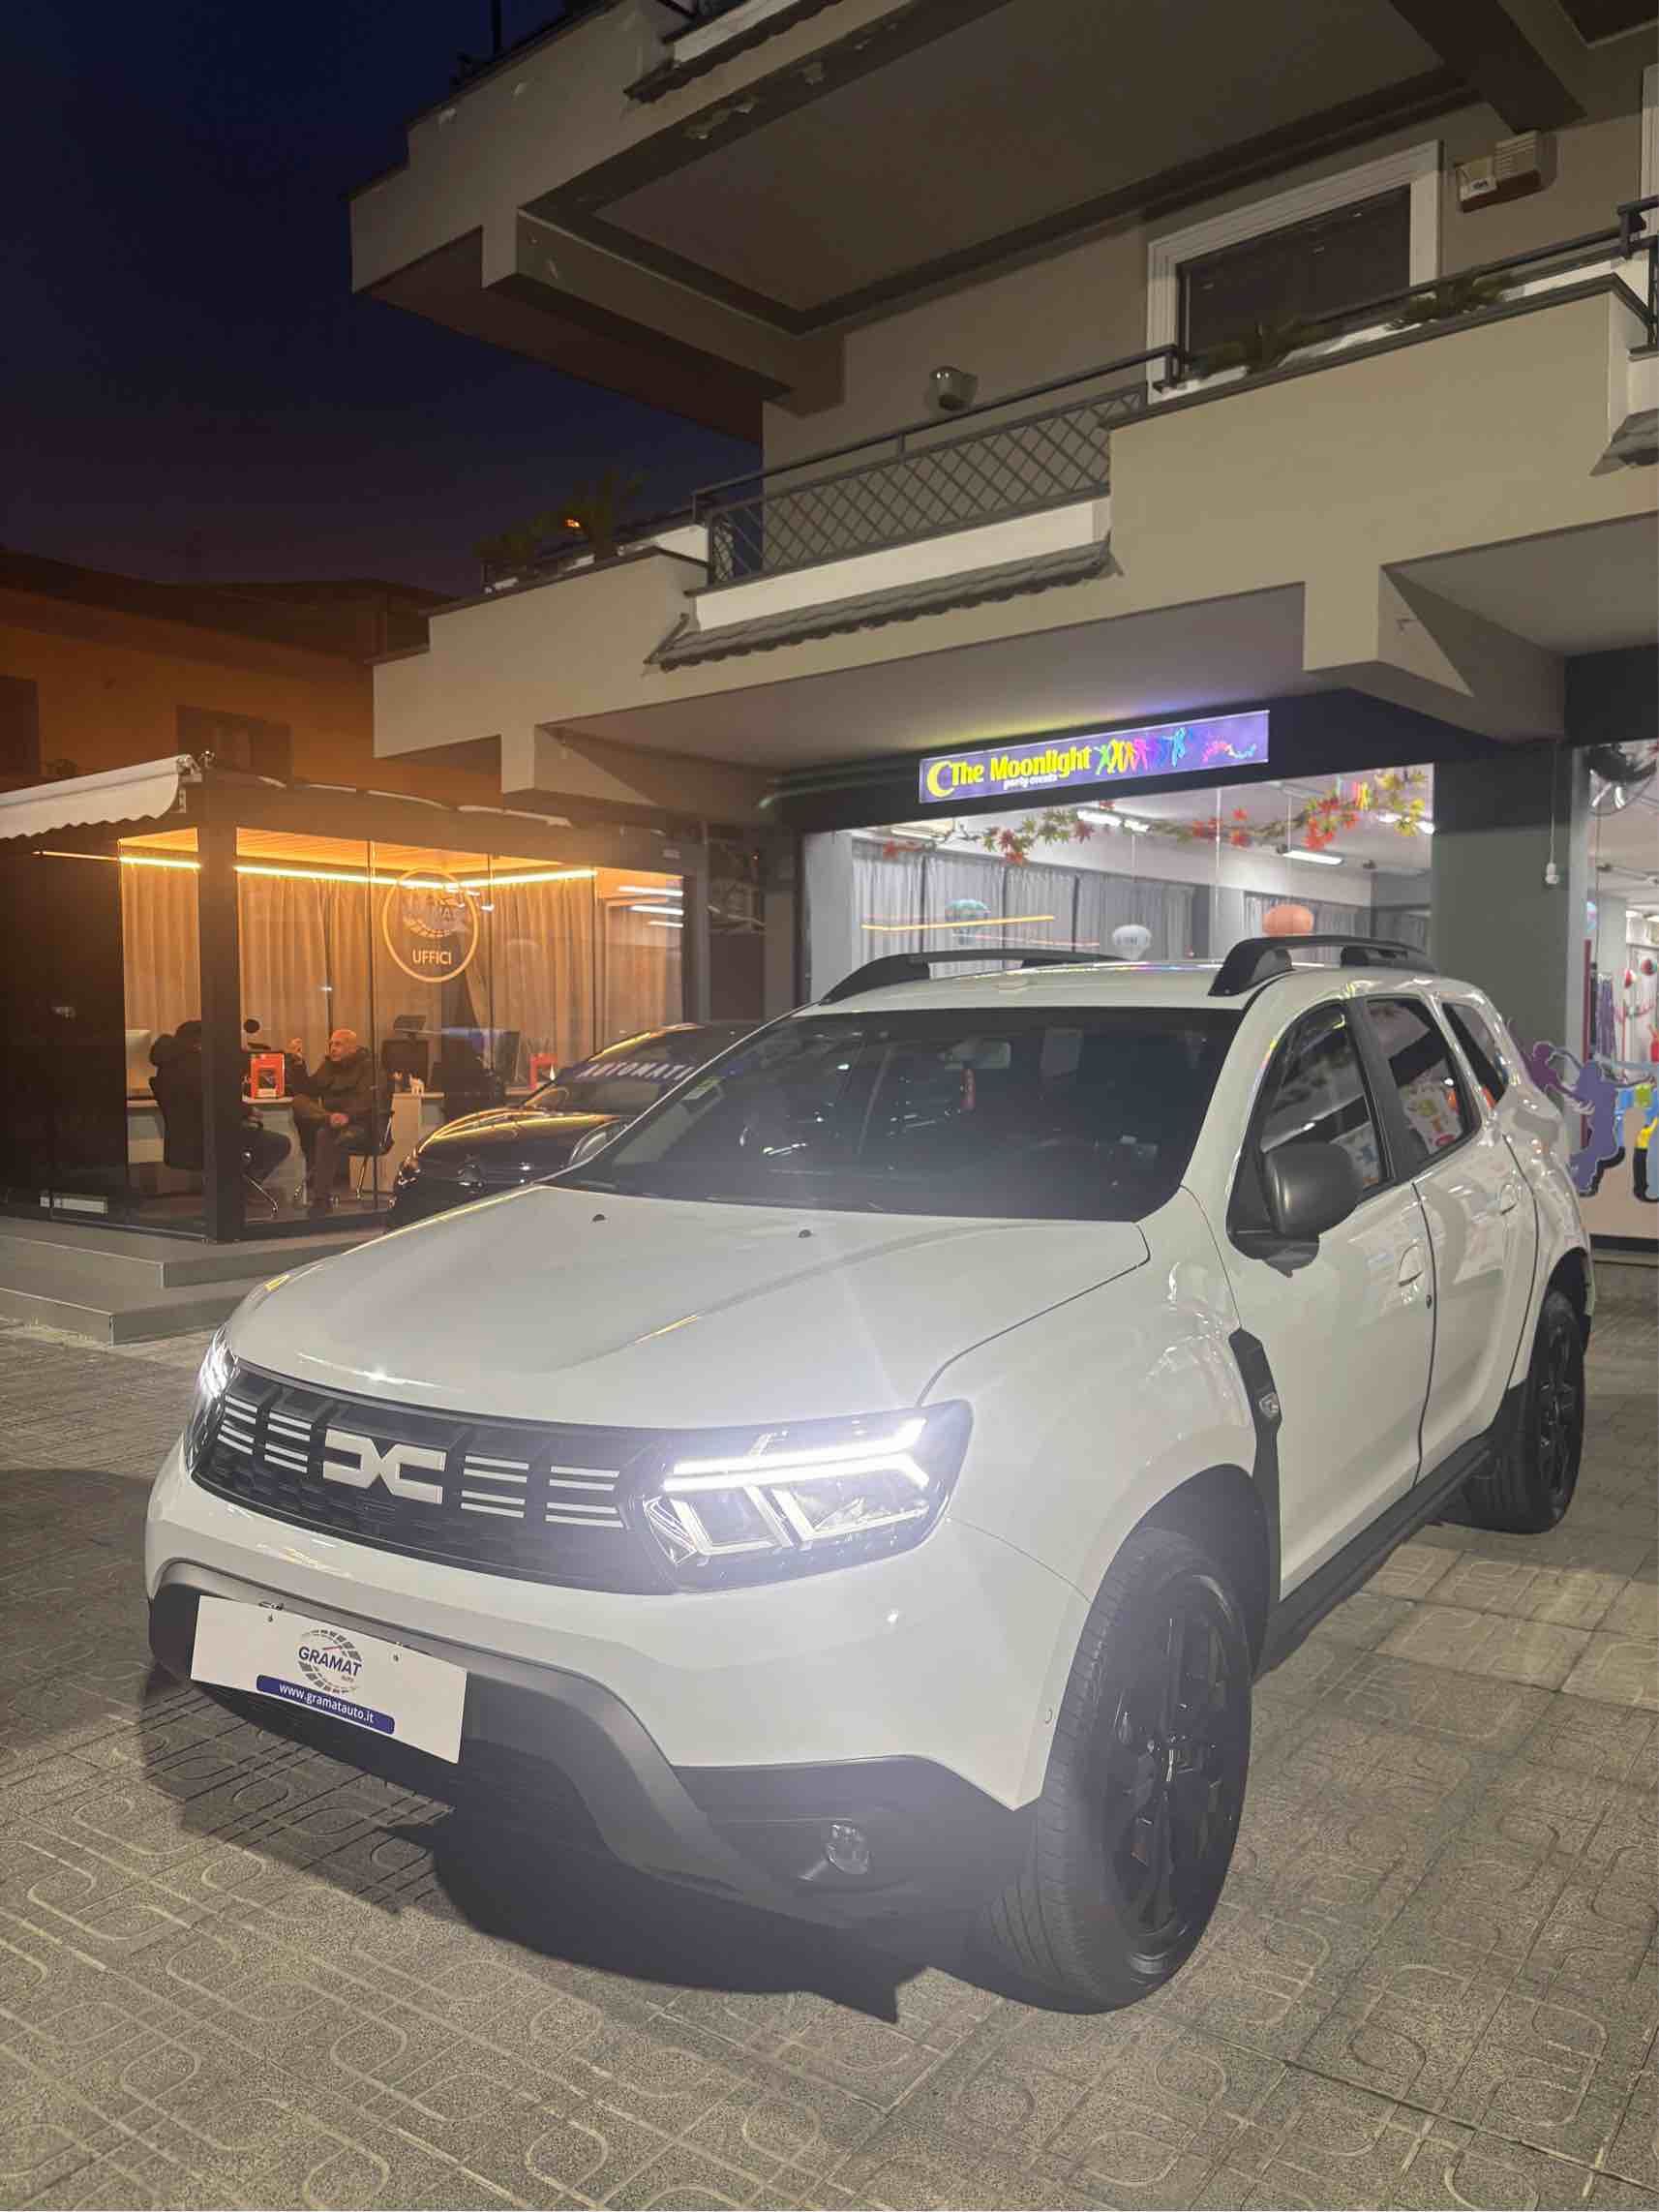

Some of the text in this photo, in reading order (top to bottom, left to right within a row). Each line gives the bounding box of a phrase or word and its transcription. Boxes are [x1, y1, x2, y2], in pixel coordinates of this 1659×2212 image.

[951, 745, 1092, 786] The Moonlight
[411, 949, 452, 965] UFFICI
[298, 1646, 362, 1677] GRAMAT
[278, 1682, 375, 1724] www.gramatauto.it
